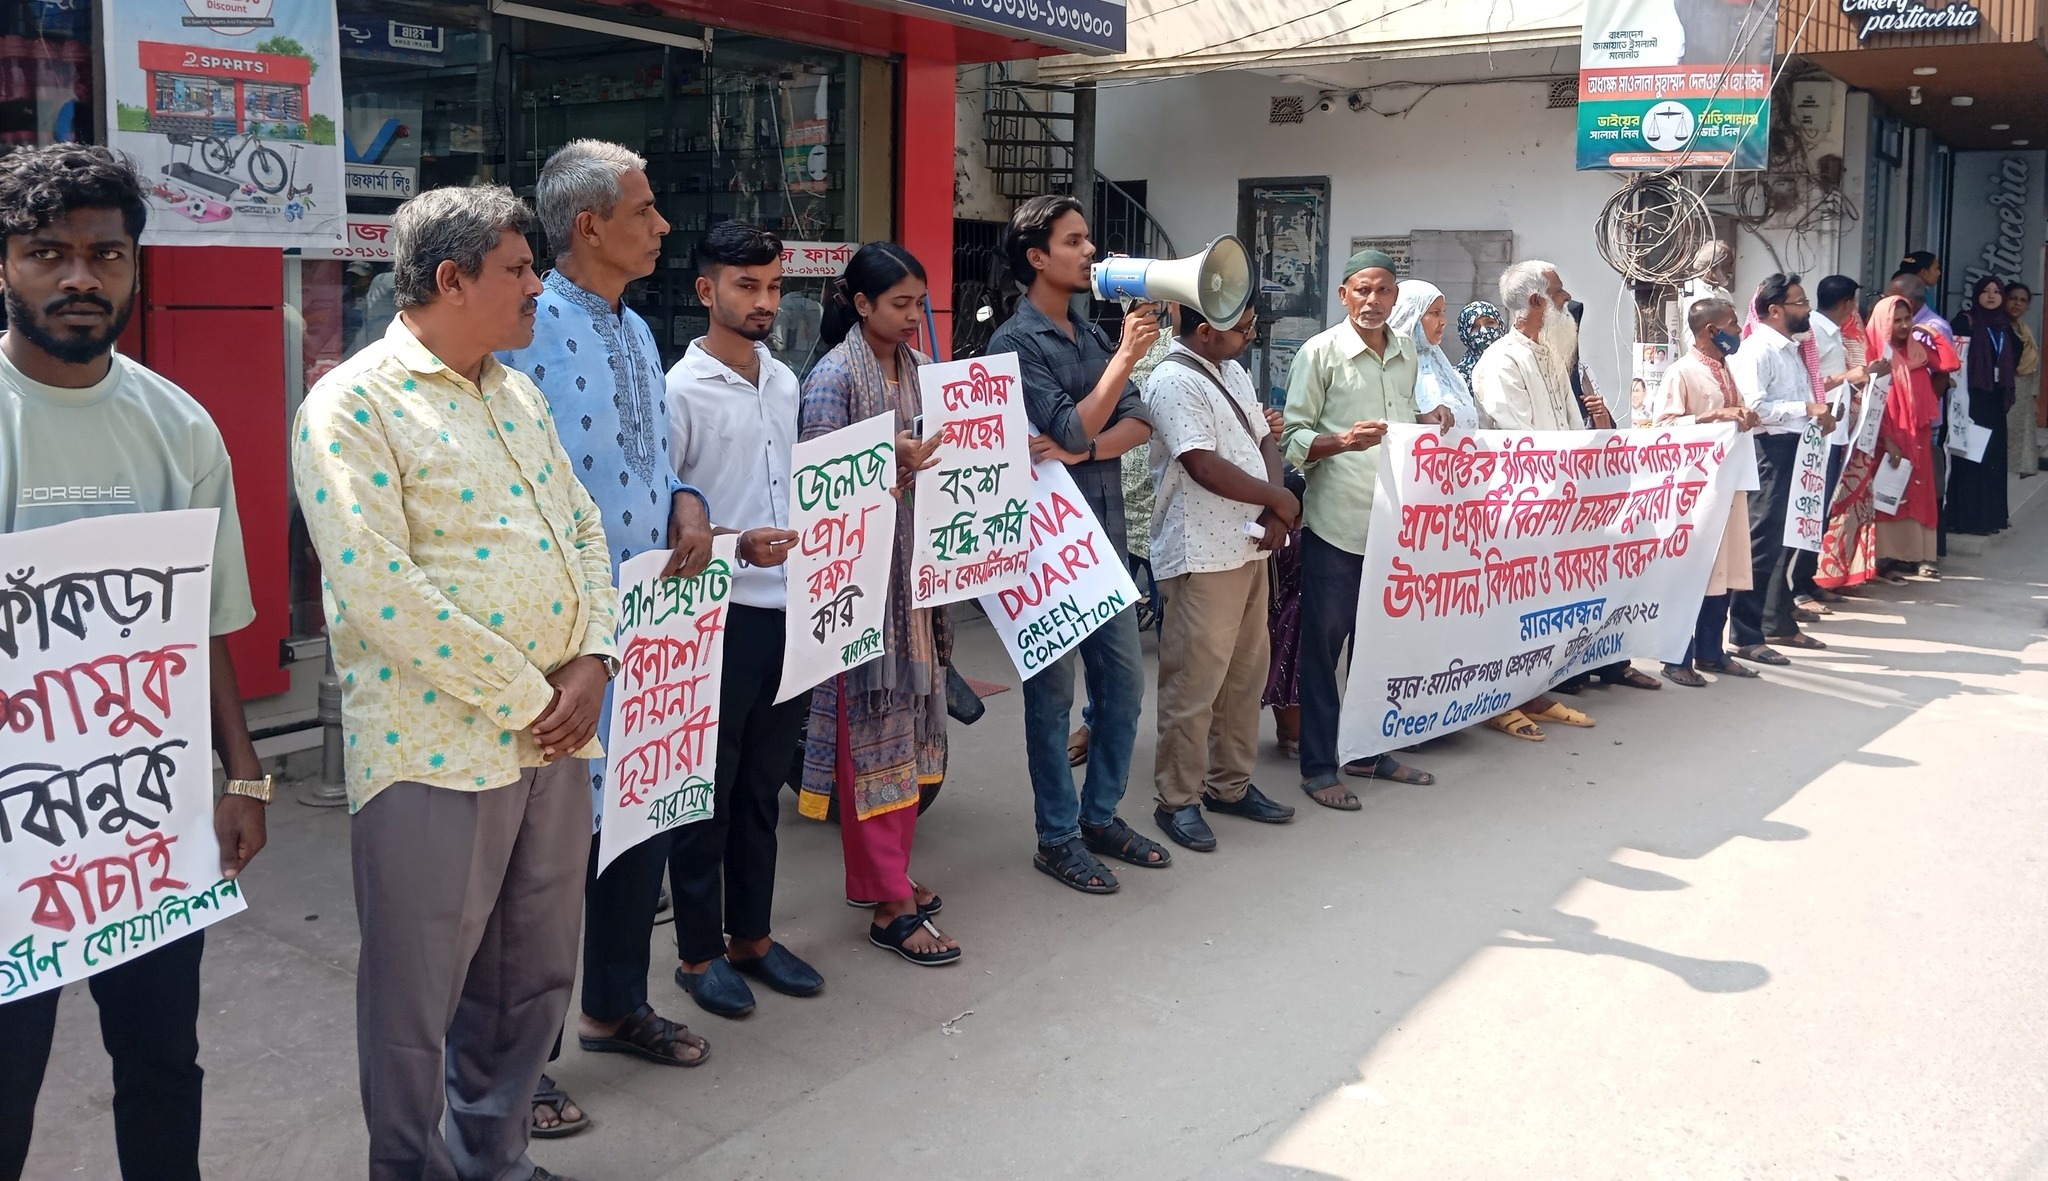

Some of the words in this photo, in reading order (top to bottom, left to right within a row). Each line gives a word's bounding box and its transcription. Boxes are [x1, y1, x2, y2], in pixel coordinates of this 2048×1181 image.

[207, 0, 248, 13] Discount
[1859, 4, 1978, 40] pasticceria
[1608, 30, 1643, 40] বাংলাদেশ
[792, 441, 895, 512] জলজ
[937, 462, 1010, 505] বংশ
[1397, 503, 1453, 553] প্রাণ
[997, 531, 1101, 621] DUARY
[1017, 594, 1083, 651] GREEN
[1023, 589, 1126, 670] COALITION
[1519, 597, 1607, 642] মানববন্ধন
[620, 673, 711, 737] চায়না
[1382, 709, 1438, 738] Green
[1442, 687, 1512, 728] Coalition
[614, 704, 719, 808] দুয়ারী
[17, 830, 191, 932] বাঁচাই
